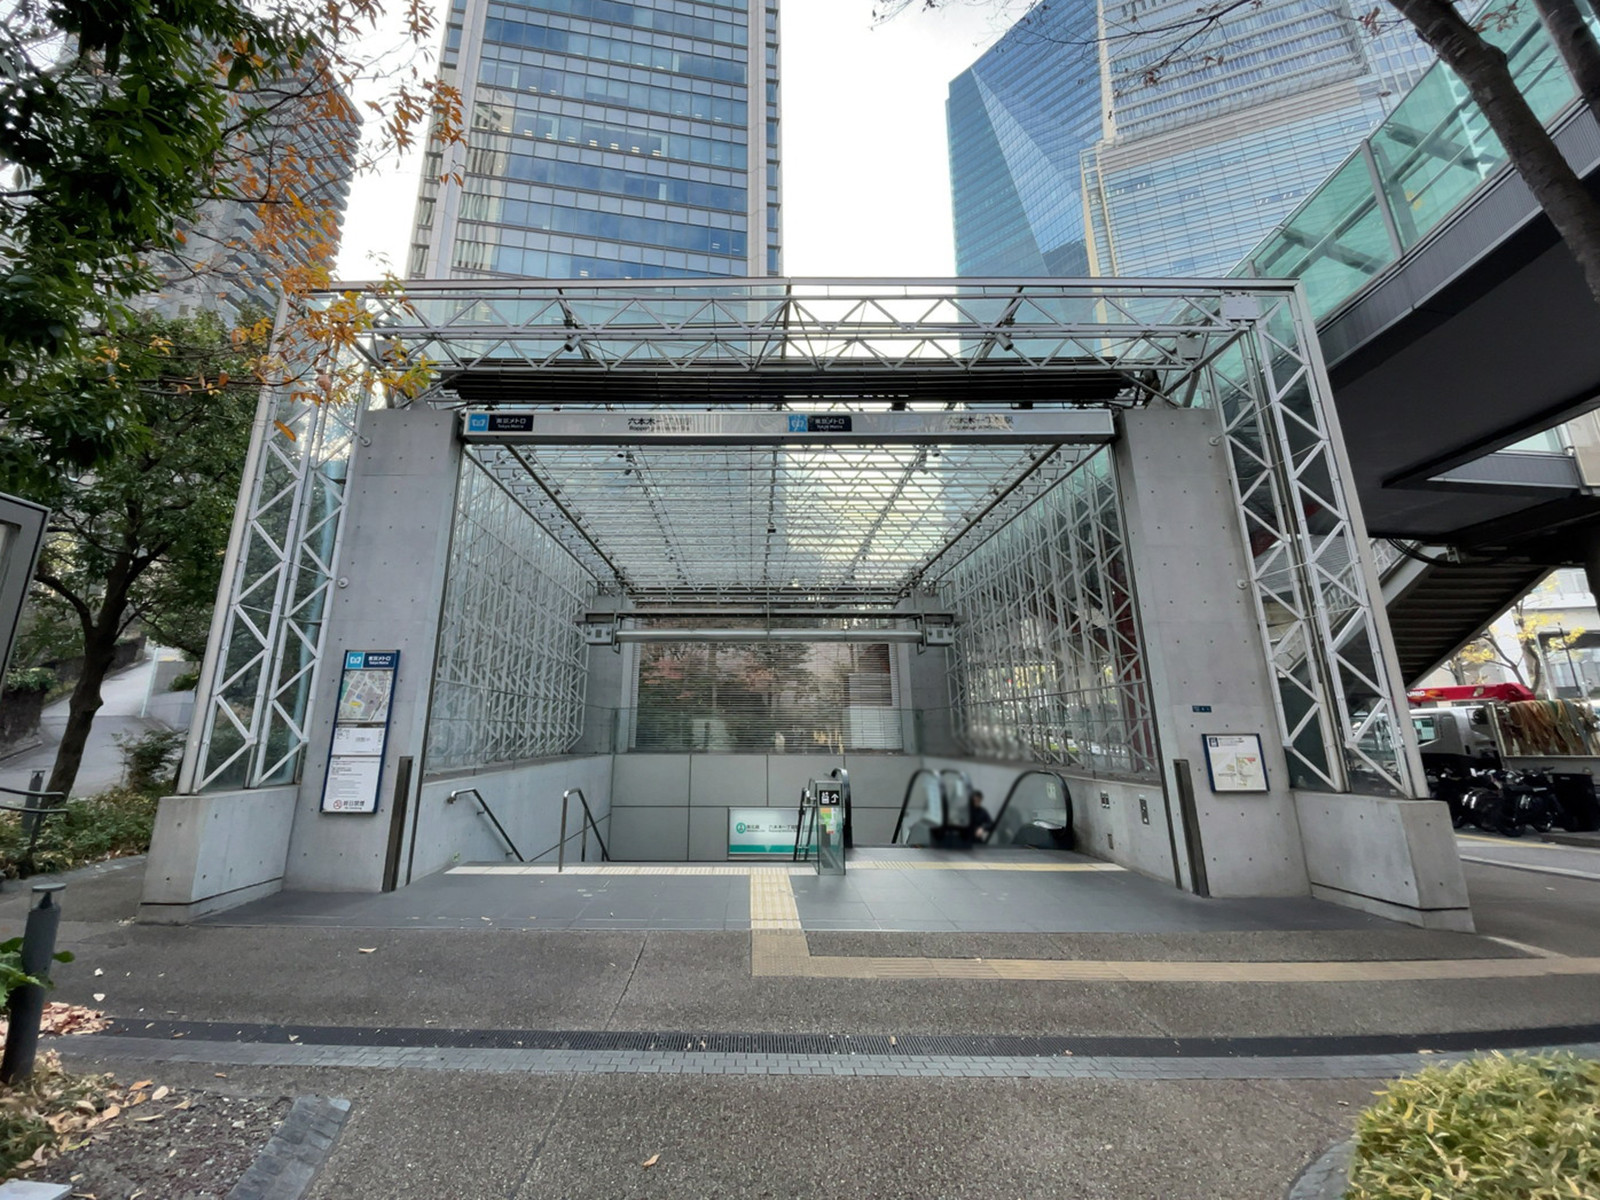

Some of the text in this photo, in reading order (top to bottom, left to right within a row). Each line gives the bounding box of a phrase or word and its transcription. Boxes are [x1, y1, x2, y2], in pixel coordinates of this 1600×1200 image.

[815, 417, 845, 425] 東京メトロ
